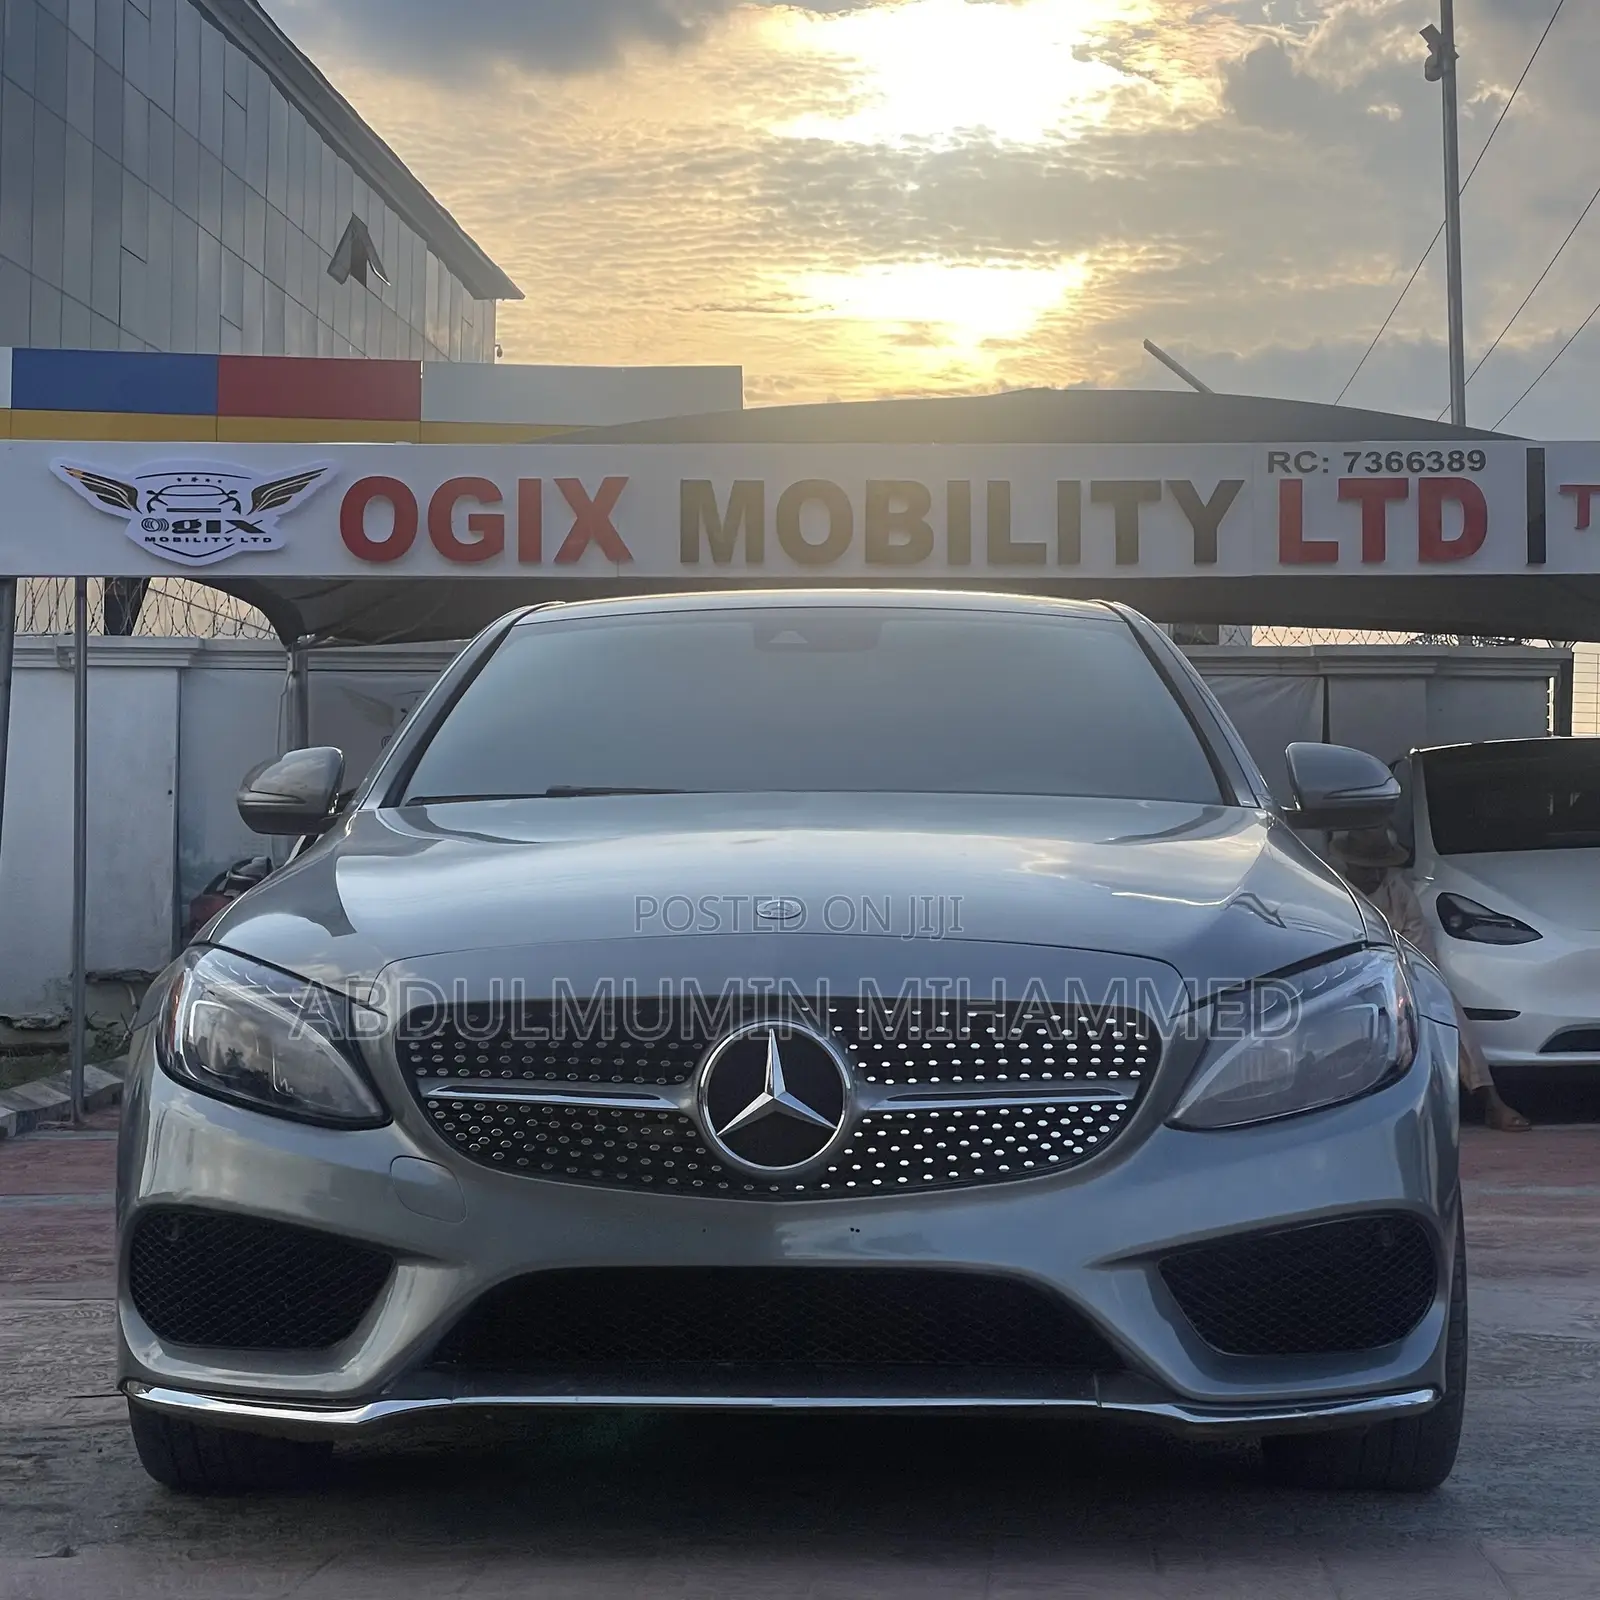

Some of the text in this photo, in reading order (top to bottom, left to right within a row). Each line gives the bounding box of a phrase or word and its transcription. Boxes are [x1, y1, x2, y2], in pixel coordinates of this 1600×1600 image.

[1267, 450, 1486, 473] RC: 7366389
[339, 475, 1488, 565] OGIX MOBILITY LTD
